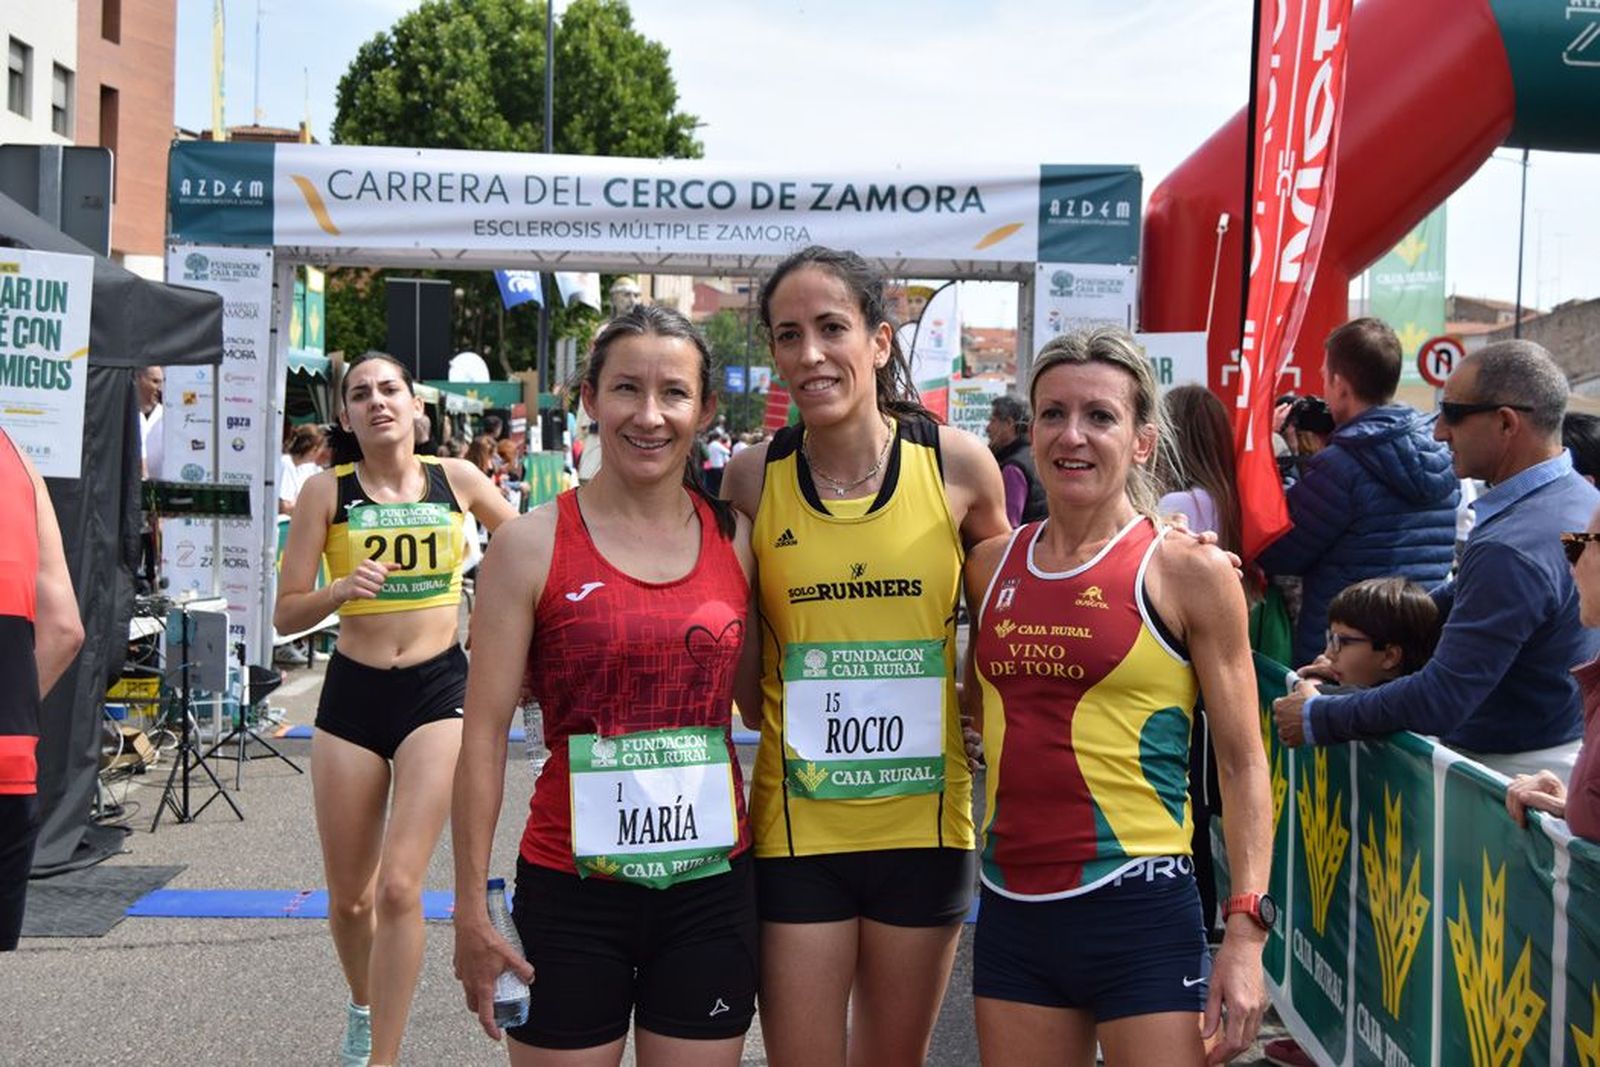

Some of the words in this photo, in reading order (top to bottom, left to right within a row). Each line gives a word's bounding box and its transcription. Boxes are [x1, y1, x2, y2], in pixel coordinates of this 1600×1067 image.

[327, 170, 509, 204] CARRERA
[524, 175, 591, 207] DEL
[603, 178, 736, 210] CERCO
[750, 182, 796, 212] DE
[810, 183, 985, 214] ZAMORA
[473, 220, 601, 239] ESCLEROSIS
[609, 218, 708, 241] MÚLTIPLE
[716, 223, 811, 243] ZAMORA
[0, 275, 32, 311] AR
[35, 279, 68, 314] UN
[13, 316, 62, 352] CON
[226, 416, 251, 430] gaza
[380, 516, 405, 526] CAJA
[406, 515, 440, 525] RURAL
[364, 531, 437, 571] 201
[381, 583, 410, 593] CAJA
[412, 580, 447, 592] RURAL
[816, 579, 922, 601] RUNNERS
[1017, 625, 1047, 635] CAJA
[1050, 626, 1093, 638] RURAL
[832, 648, 924, 663] FUNDACION
[1008, 643, 1066, 660] VINO
[832, 663, 871, 677] CAJA
[873, 662, 925, 676] RURAL
[990, 660, 1017, 677] DE
[1021, 660, 1085, 680] TORO
[825, 692, 841, 713] 15
[622, 734, 708, 752] FUNDACION
[825, 715, 905, 754] ROCIO
[622, 752, 659, 767] CAJA
[663, 749, 711, 765] RURAL
[831, 770, 875, 786] CAJA
[878, 766, 935, 783] RURAL
[616, 782, 624, 803] 1
[617, 795, 699, 846] MARÍA
[622, 862, 669, 878] CAJA
